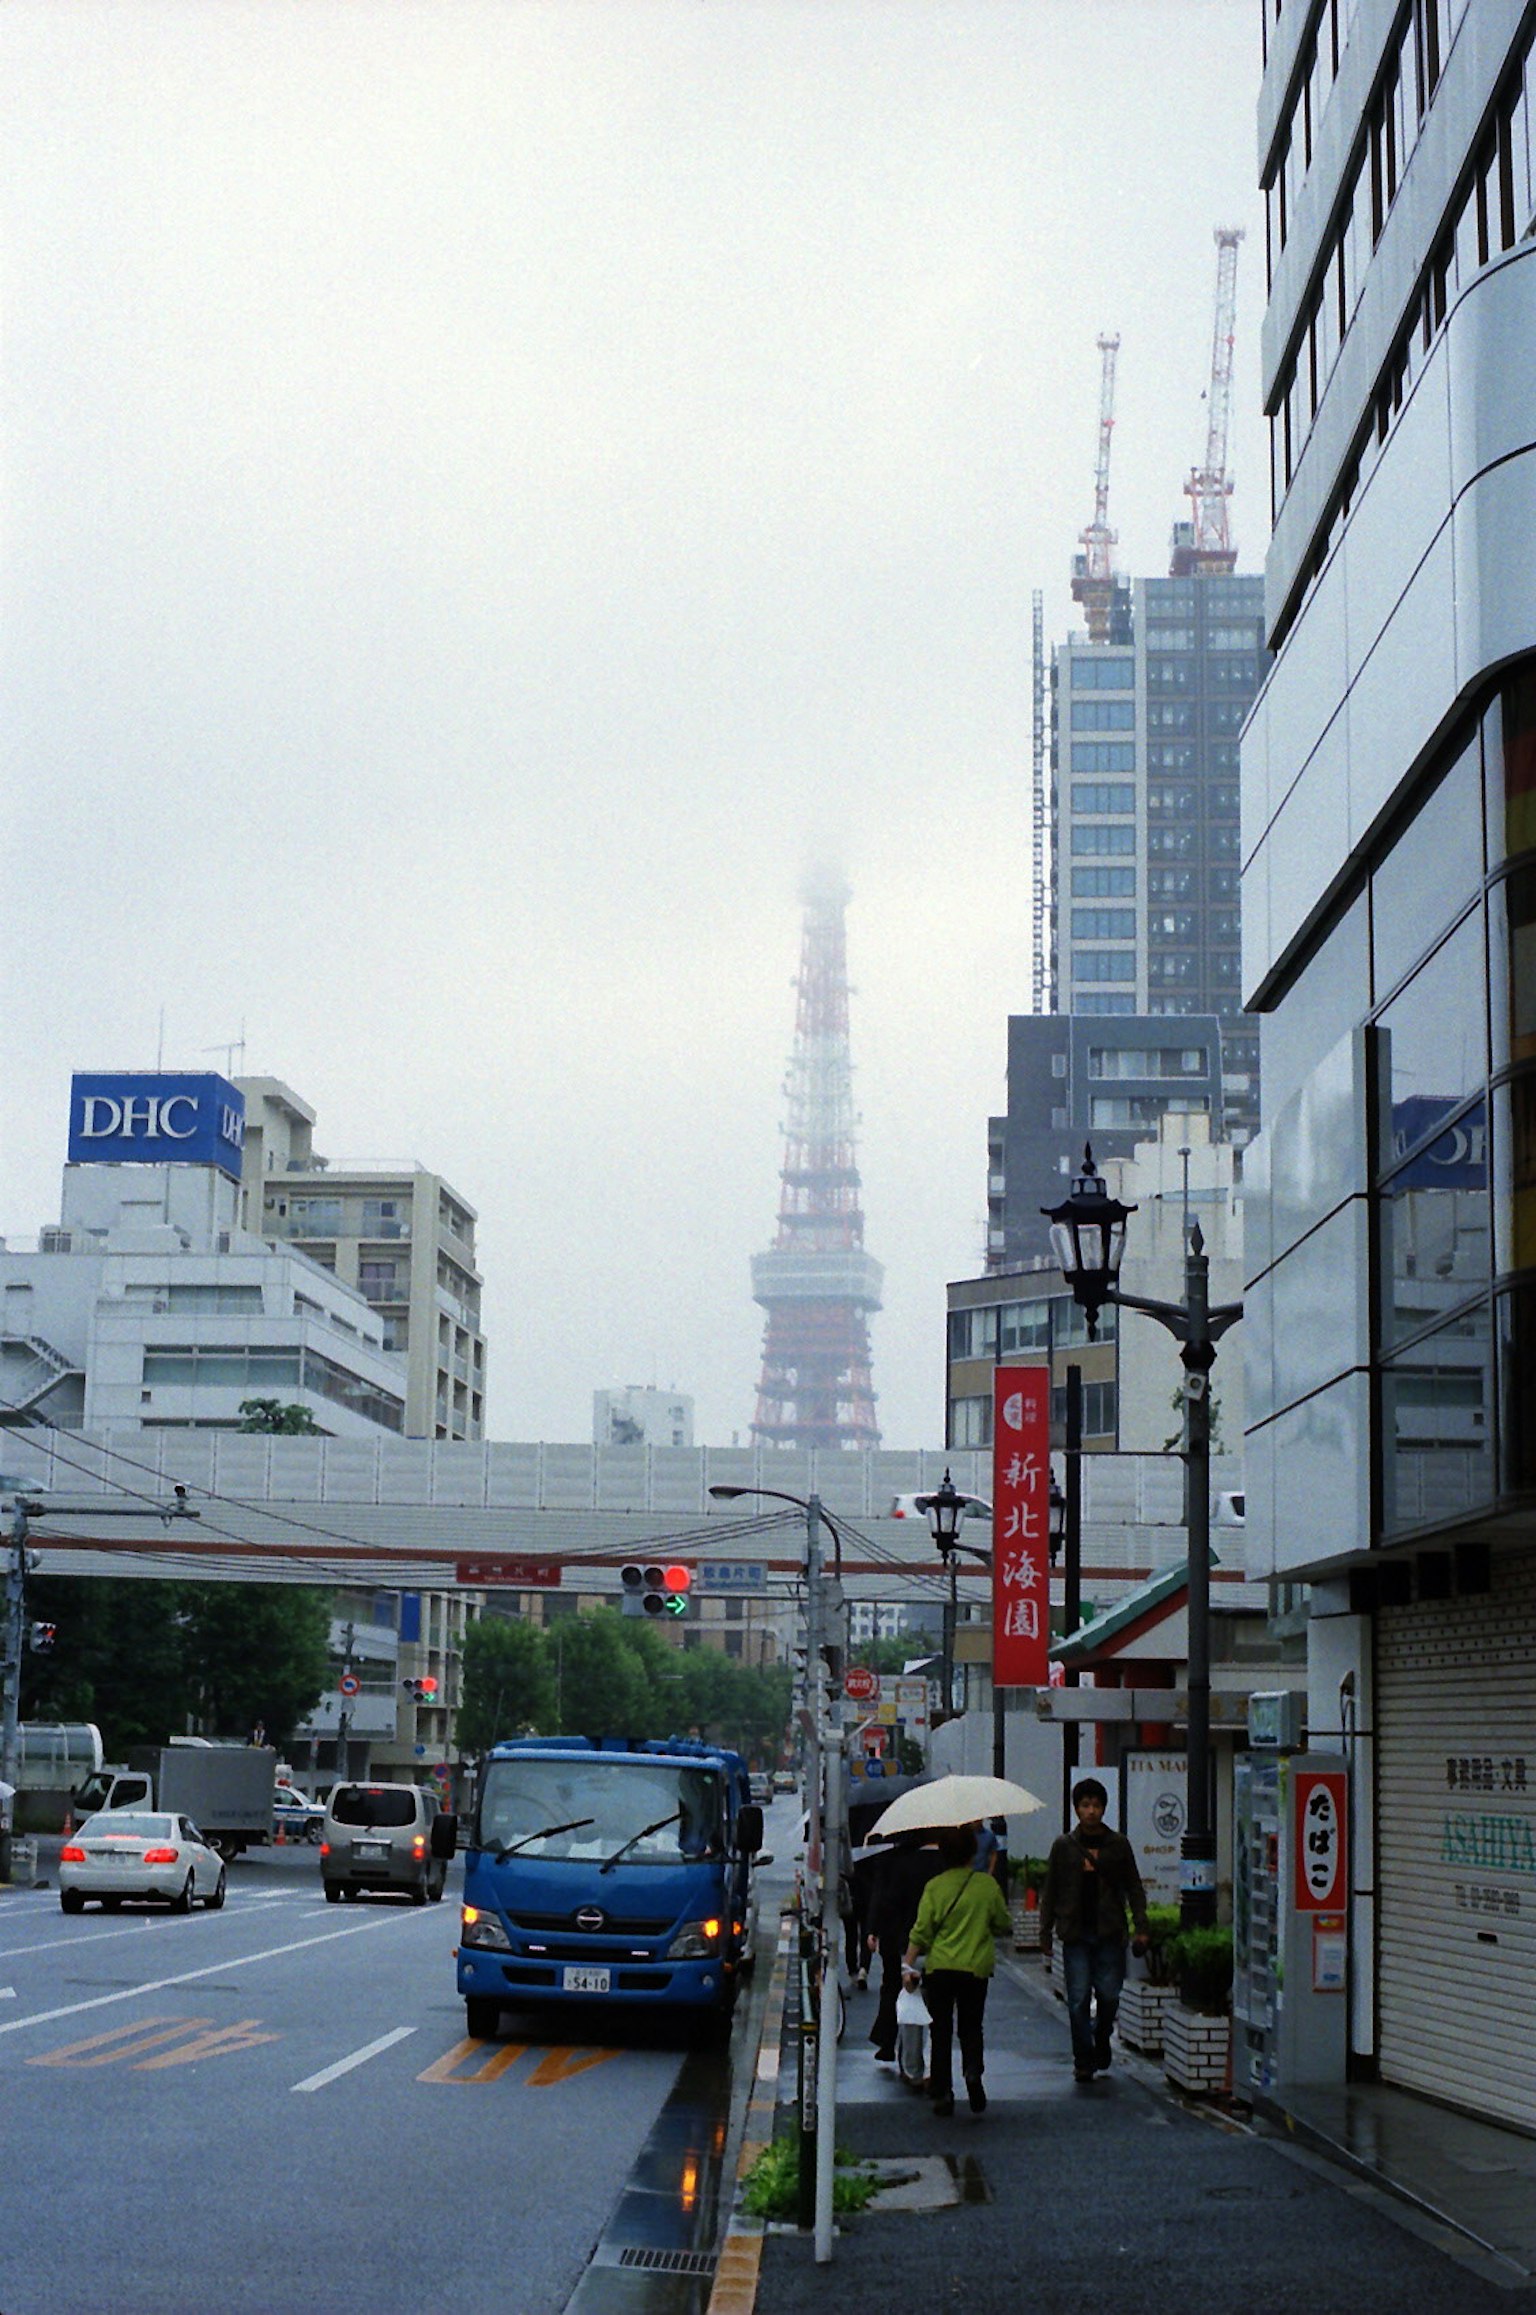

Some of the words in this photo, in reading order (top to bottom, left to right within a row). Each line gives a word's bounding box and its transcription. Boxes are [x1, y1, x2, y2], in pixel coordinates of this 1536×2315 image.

[79, 1095, 199, 1139] DHC
[1003, 1452, 1042, 1640] 新北海園
[1309, 1793, 1336, 1888] たばこ
[1440, 1813, 1536, 1872] ASAHIYA
